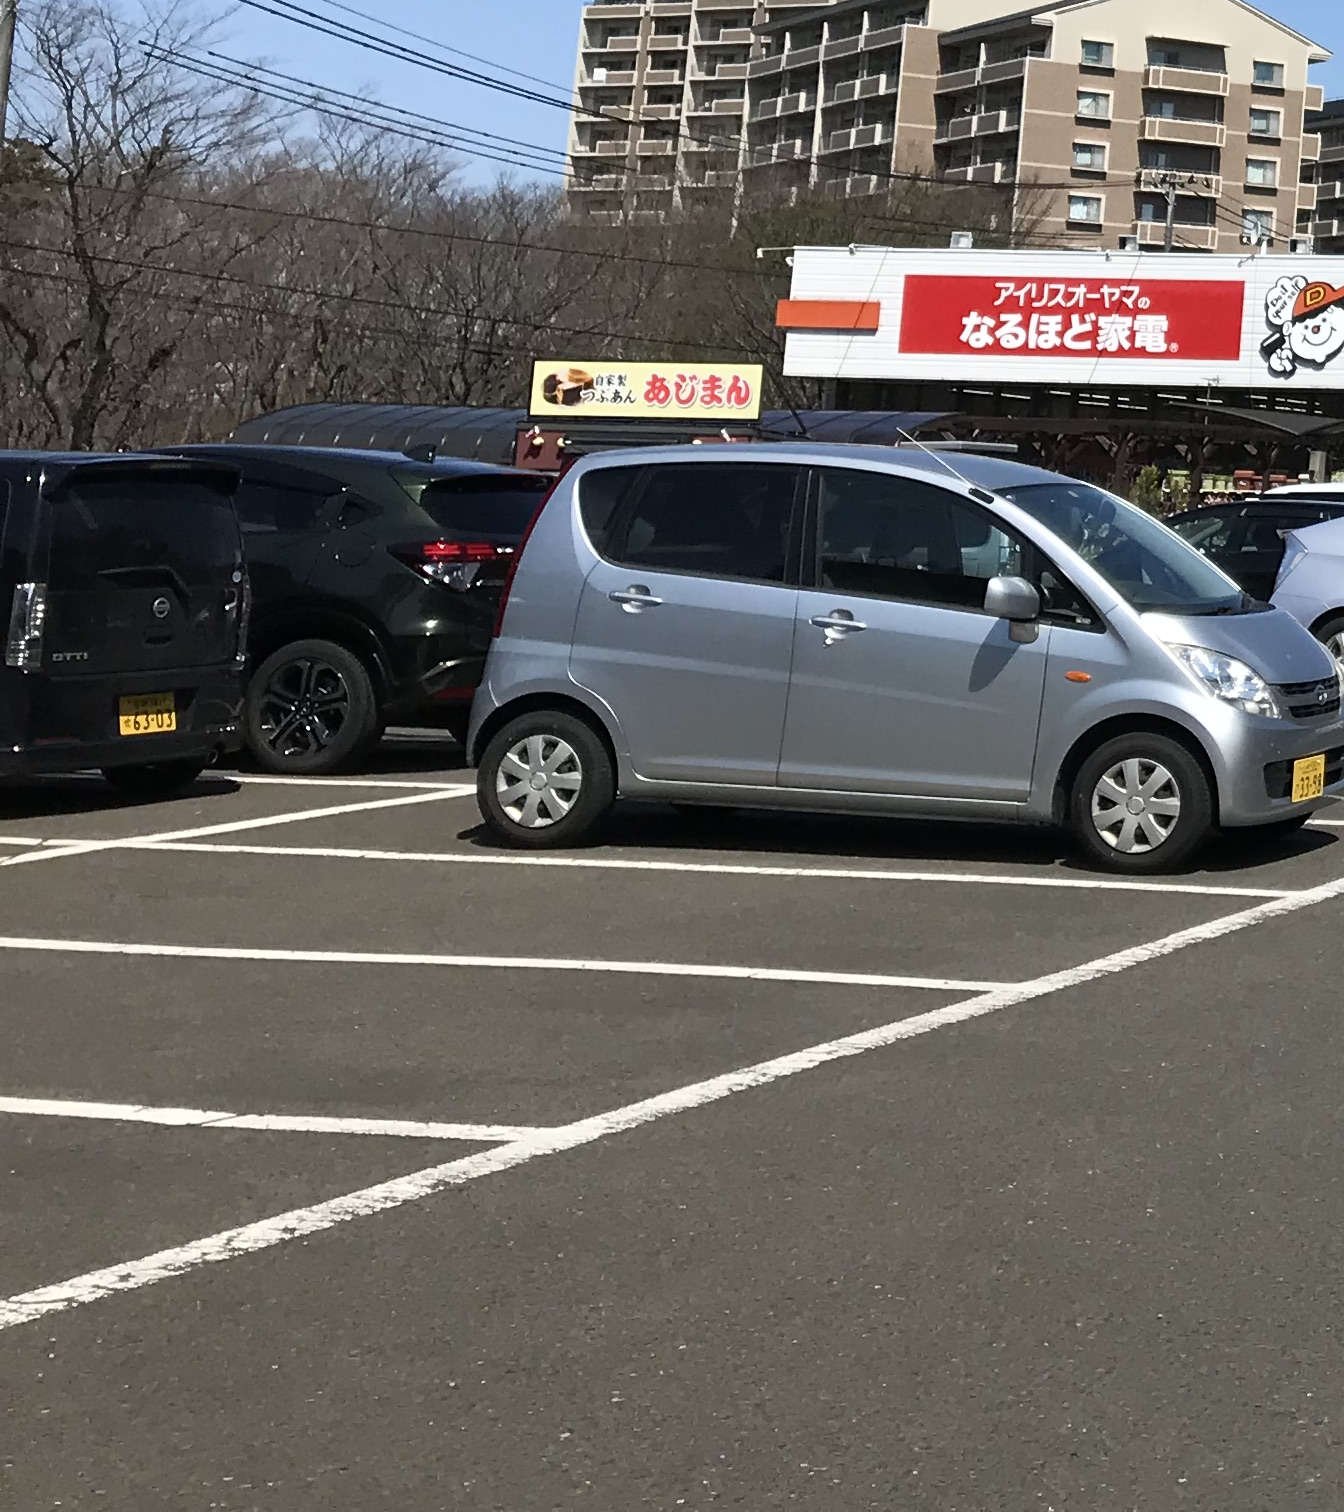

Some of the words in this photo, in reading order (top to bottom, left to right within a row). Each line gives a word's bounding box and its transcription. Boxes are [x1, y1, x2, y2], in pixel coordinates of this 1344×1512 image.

[993, 282, 1151, 309] アイリスオーヤマの
[1304, 285, 1326, 307] D
[959, 311, 1169, 353] なるほど家電
[595, 374, 627, 388] 自家製
[643, 374, 752, 407] あじまん
[581, 389, 637, 404] つぶあん
